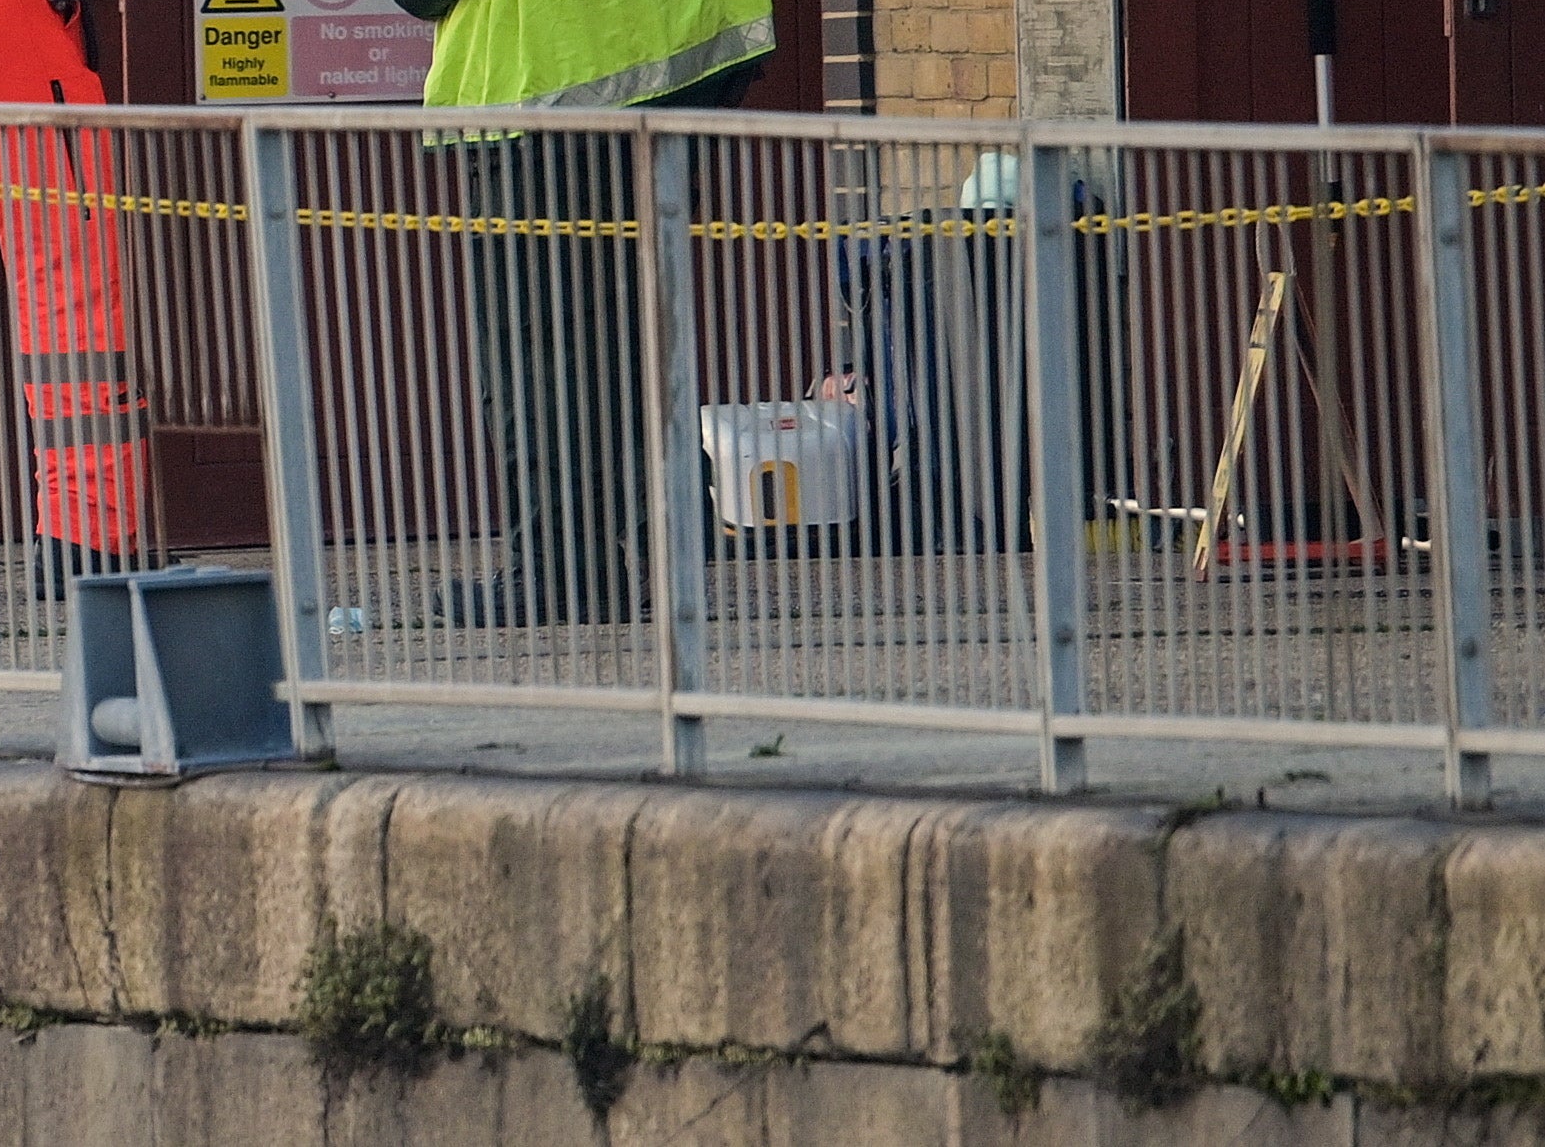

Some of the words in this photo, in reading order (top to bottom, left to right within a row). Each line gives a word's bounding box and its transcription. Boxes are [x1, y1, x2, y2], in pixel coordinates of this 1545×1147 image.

[205, 27, 283, 49] Danger
[321, 23, 347, 40] No
[352, 21, 434, 42] smoking
[369, 47, 389, 61] or
[222, 57, 265, 72] Highly
[209, 74, 279, 87] flammable
[320, 67, 378, 85] naked
[385, 66, 426, 86] light
